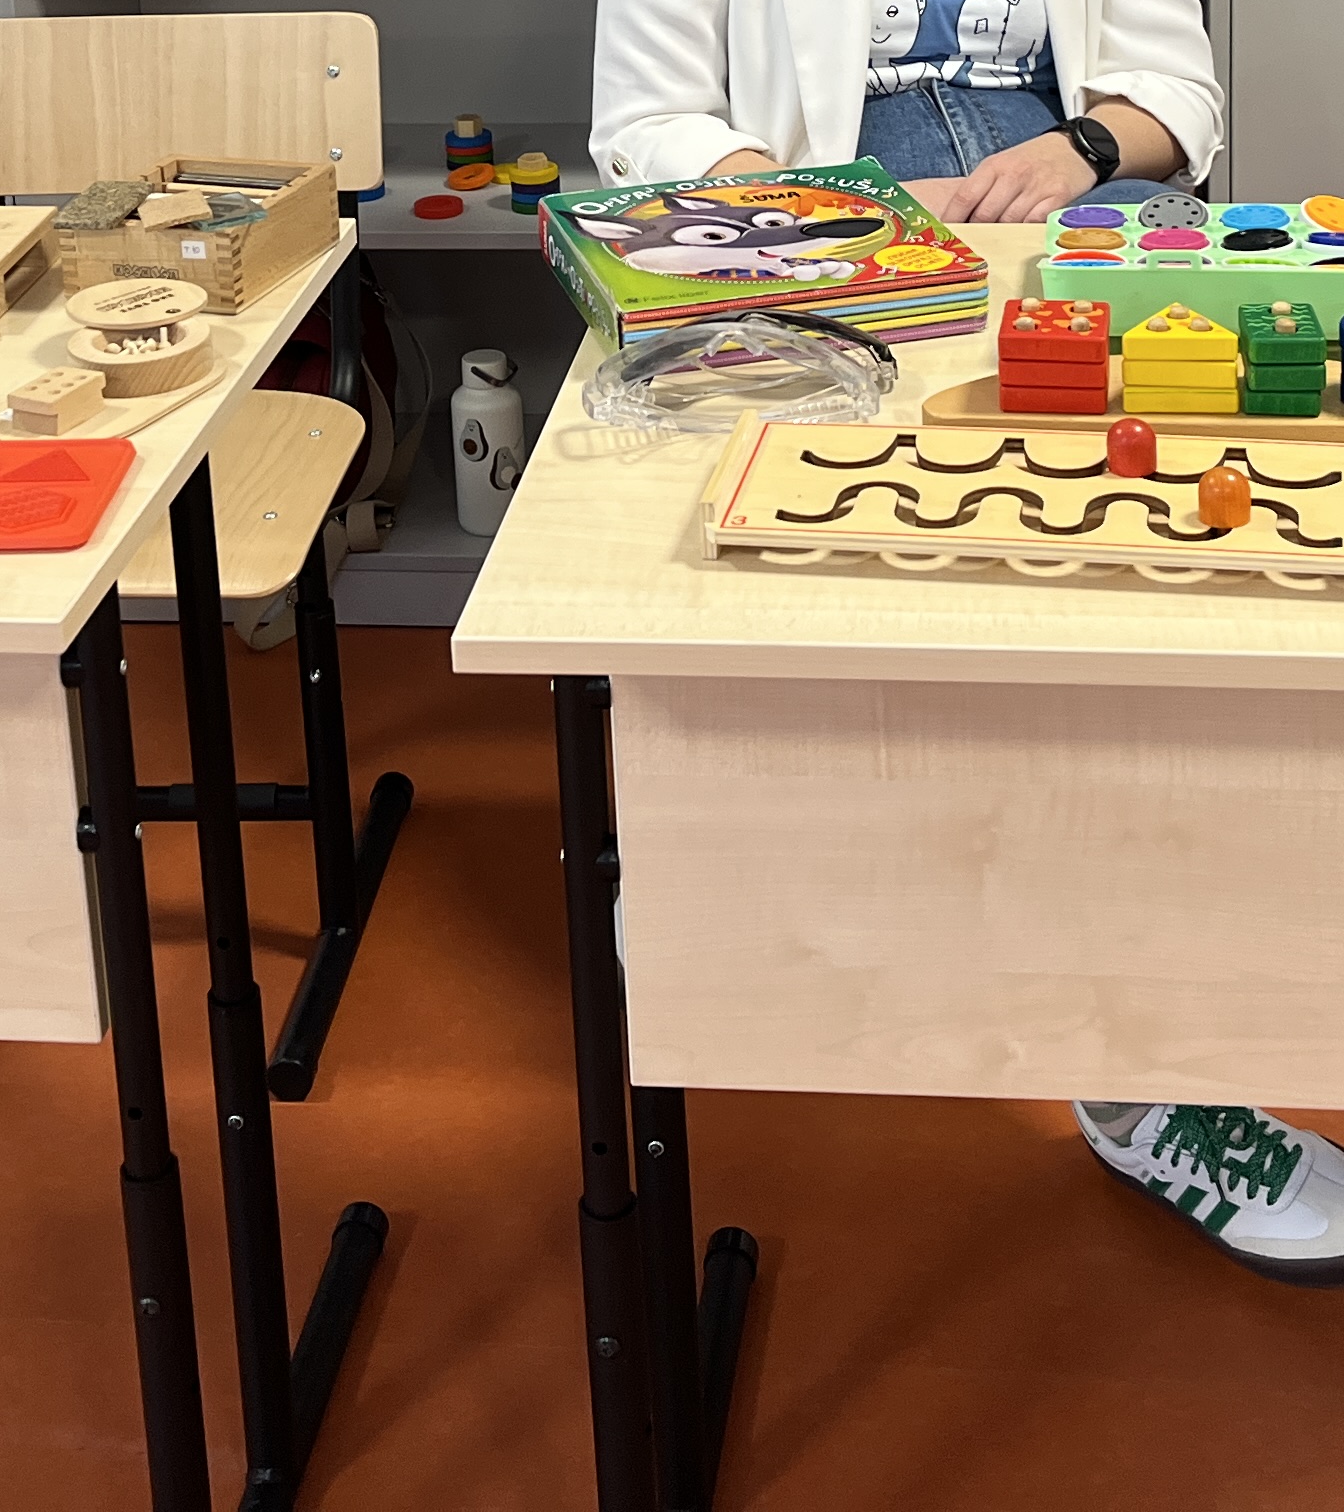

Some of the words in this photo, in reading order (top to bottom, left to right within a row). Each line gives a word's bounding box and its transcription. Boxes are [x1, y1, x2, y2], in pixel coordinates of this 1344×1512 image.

[571, 187, 656, 215] OPIPAJ
[739, 191, 801, 203] ŠUMA
[731, 515, 747, 525] 3
